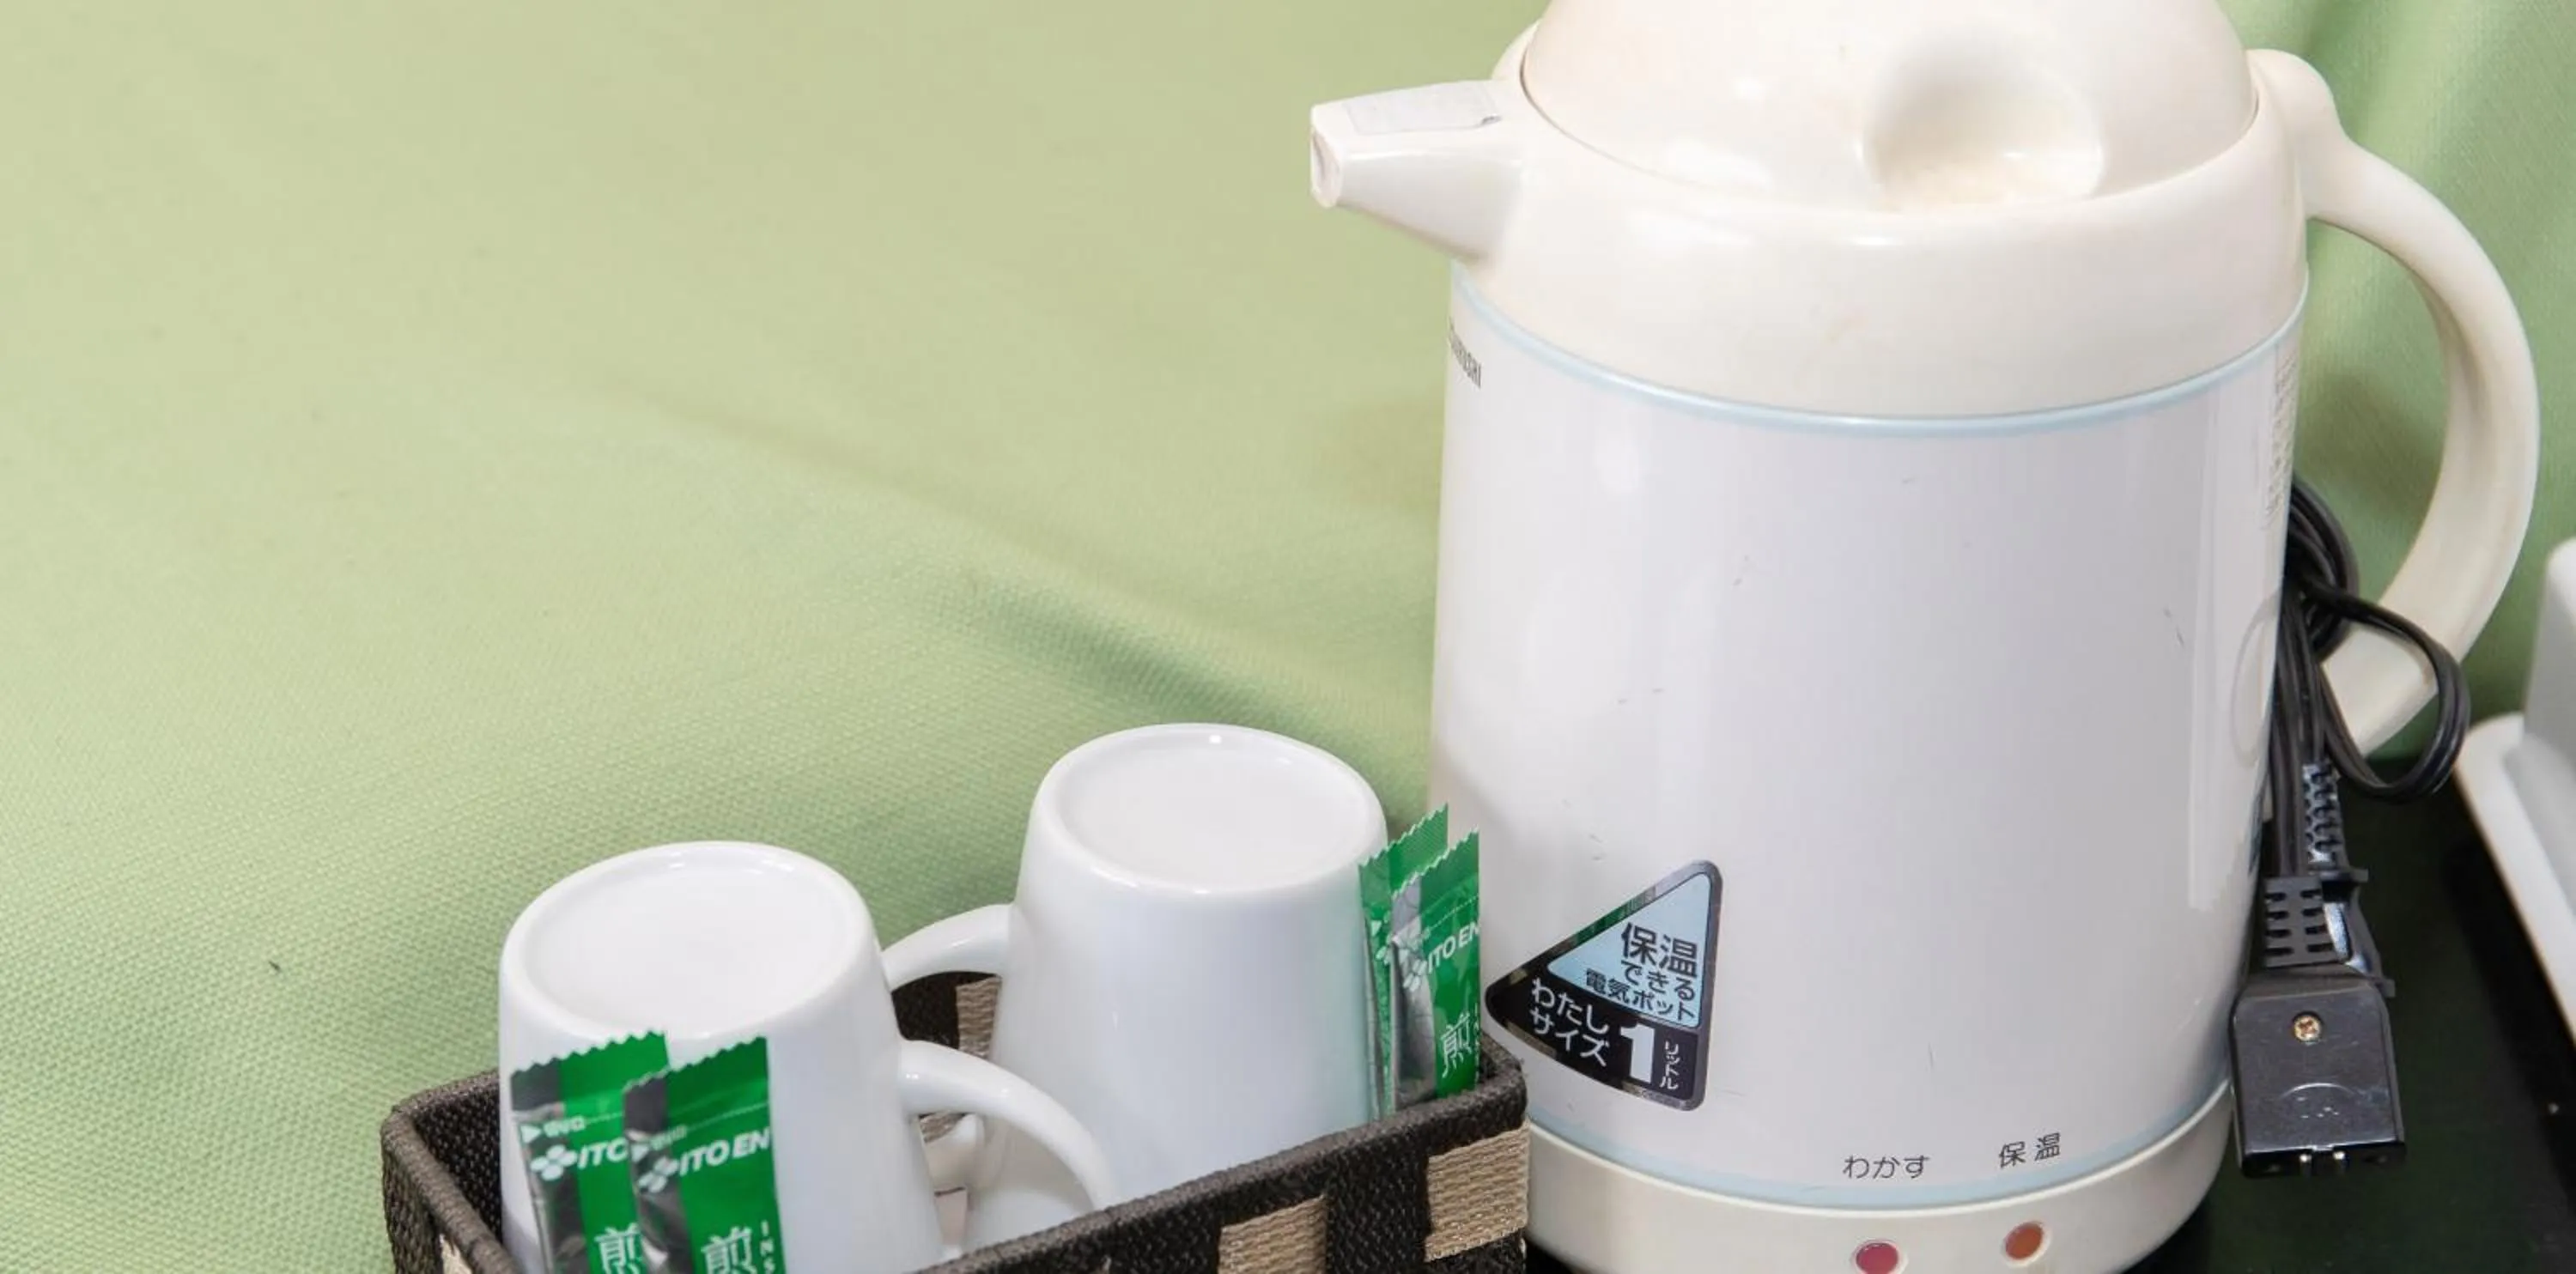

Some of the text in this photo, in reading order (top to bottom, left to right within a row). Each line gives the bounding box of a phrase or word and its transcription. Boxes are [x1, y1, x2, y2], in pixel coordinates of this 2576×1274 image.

[1428, 935, 1456, 974] ITO
[1621, 921, 1698, 979] 保温
[1530, 976, 1609, 1034] わたし
[1586, 968, 1695, 1022] 電気ポット
[1621, 960, 1696, 1002] できる
[1528, 1007, 1610, 1067] サイズ
[1619, 1022, 1656, 1084] 1
[1659, 1040, 1680, 1090] リットル
[678, 1127, 771, 1177] ITO EN
[1842, 1155, 1930, 1180] わかす
[1998, 1131, 2061, 1169] 保温
